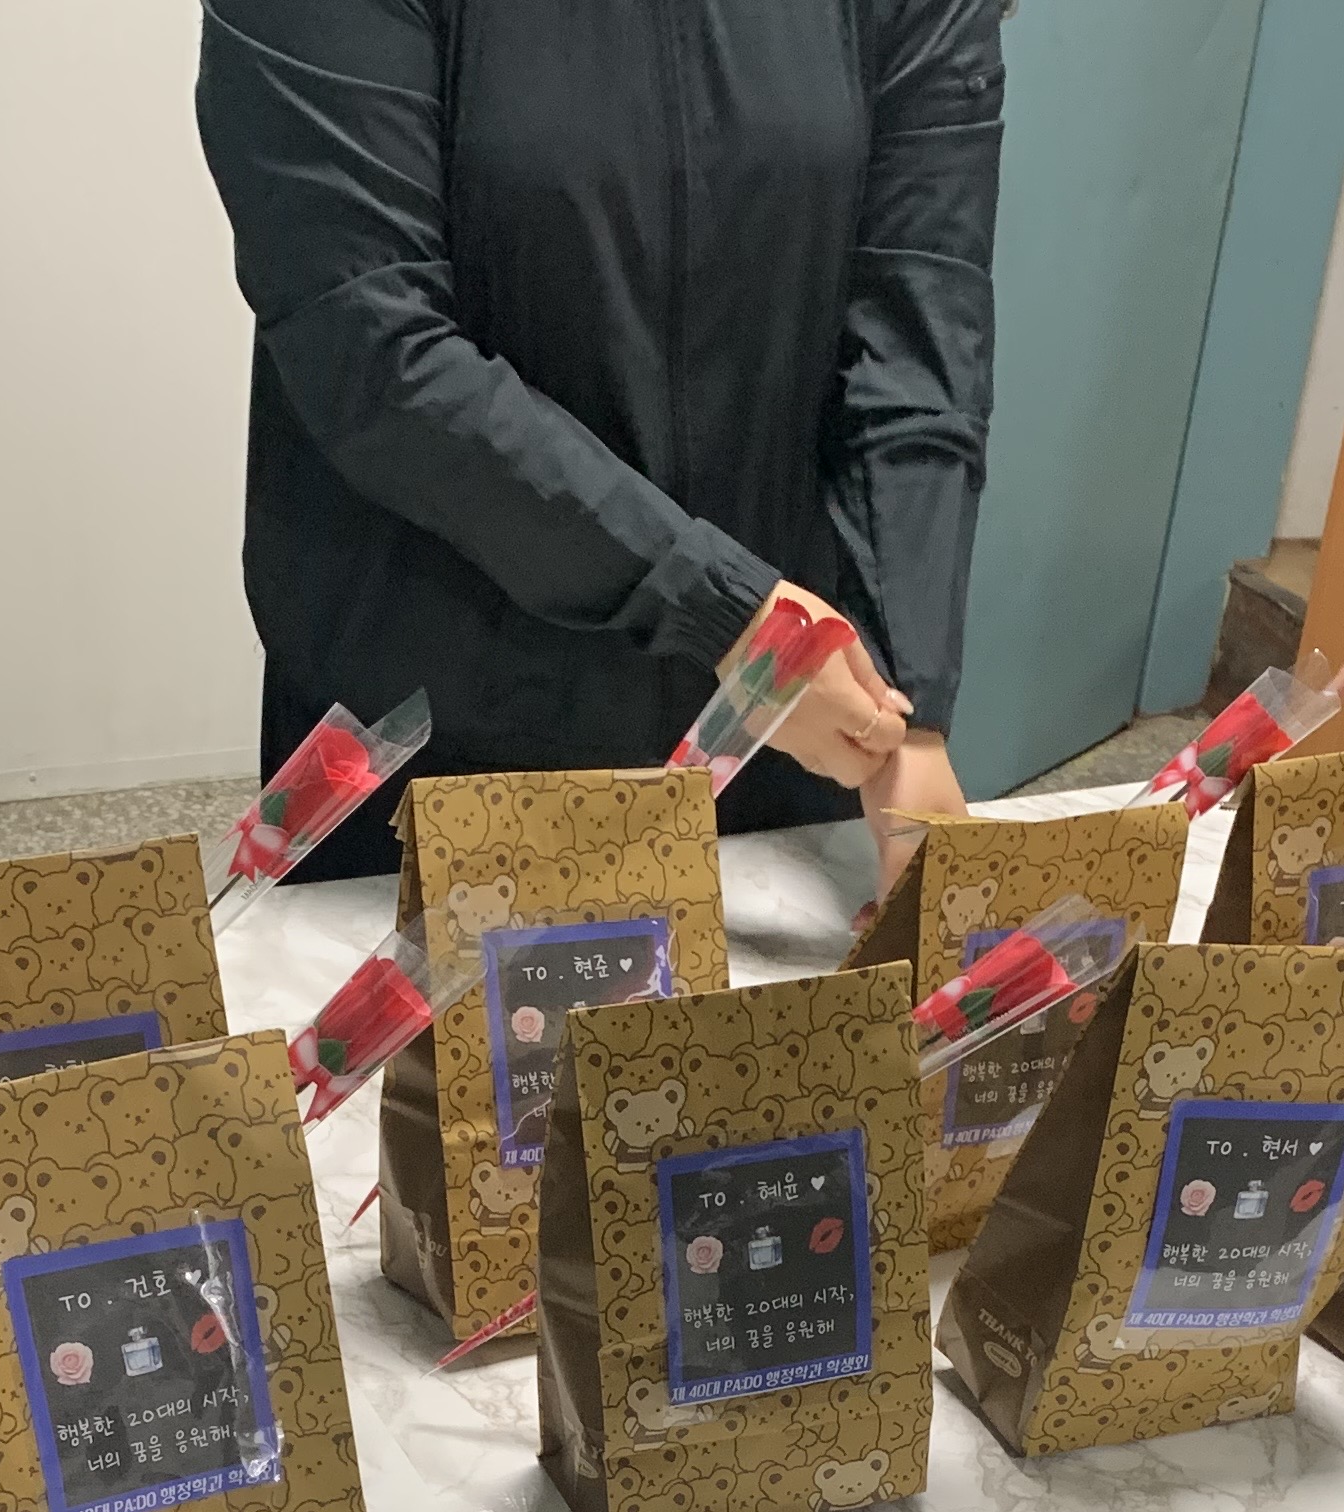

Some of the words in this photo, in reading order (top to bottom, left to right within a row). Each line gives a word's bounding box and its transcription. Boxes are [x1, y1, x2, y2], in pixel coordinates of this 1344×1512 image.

[574, 954, 609, 981] 현준
[512, 1071, 556, 1095] 행복한
[962, 1061, 1002, 1083] 행복한
[1010, 1057, 1055, 1075] 20대의
[974, 1091, 998, 1104] 너의
[1007, 1081, 1028, 1103] 꿈을
[1262, 1134, 1299, 1161] 현서
[757, 1171, 799, 1201] 혜윤
[1162, 1242, 1208, 1265] 행복한
[1218, 1244, 1270, 1261] 20대의
[1277, 1241, 1313, 1259] 시작,
[124, 1269, 172, 1300] 건호
[1173, 1275, 1201, 1288] 너의
[1211, 1268, 1236, 1292] 꿈을
[1246, 1269, 1290, 1290] 응원해
[683, 1302, 735, 1329] 행복한
[744, 1293, 804, 1317] 20대의
[813, 1284, 855, 1304] 시작,
[705, 1335, 736, 1352] 너의
[745, 1325, 774, 1349] 꿈을
[785, 1318, 836, 1343] 응원해
[977, 1307, 1025, 1351] THANK
[56, 1415, 115, 1448] 행복한
[127, 1398, 193, 1428] 20대의
[202, 1384, 250, 1410] 시작,
[87, 1452, 121, 1472] 너의
[130, 1436, 163, 1463] 꿈을
[160, 1473, 223, 1505] 행정학과
